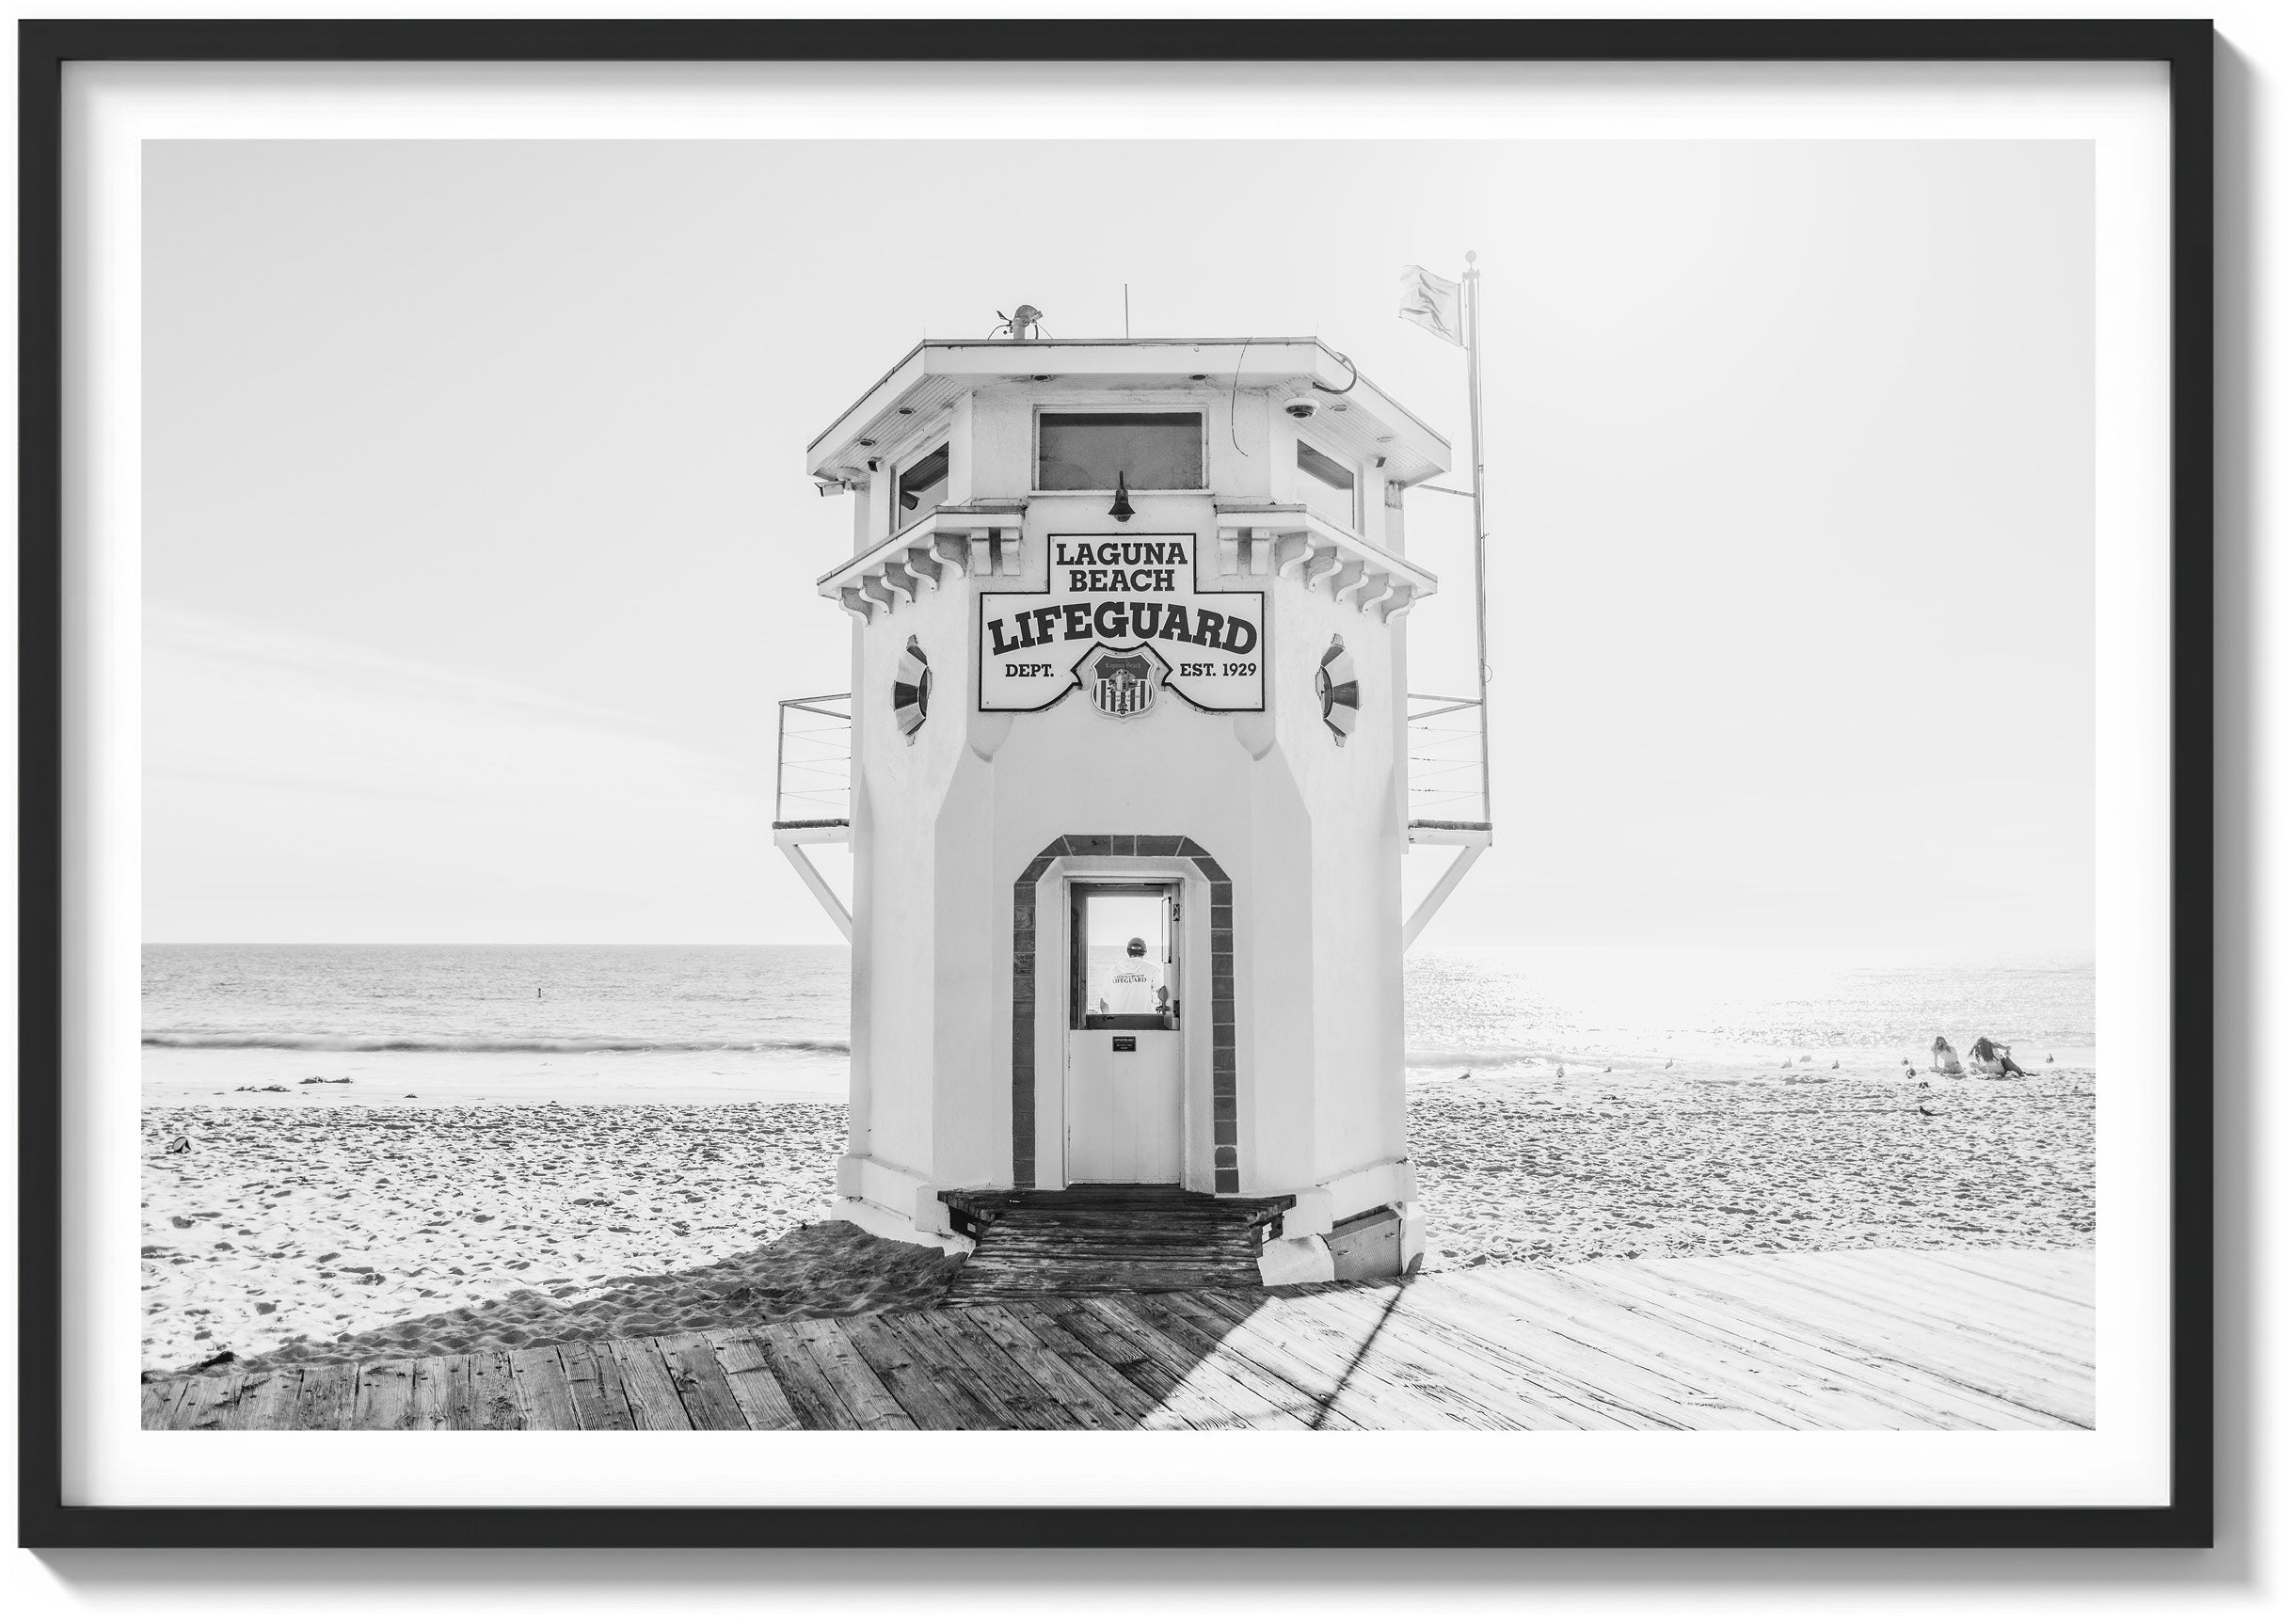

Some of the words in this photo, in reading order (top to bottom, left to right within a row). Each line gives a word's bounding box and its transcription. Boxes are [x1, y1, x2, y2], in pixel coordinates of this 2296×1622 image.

[1056, 542, 1188, 565] LAGUNA
[1069, 569, 1175, 592] BEACH
[987, 601, 1258, 656] LIFEGUARD
[1005, 663, 1055, 677] DEPT.
[1179, 662, 1217, 677] EST.
[1222, 662, 1257, 676] 1929
